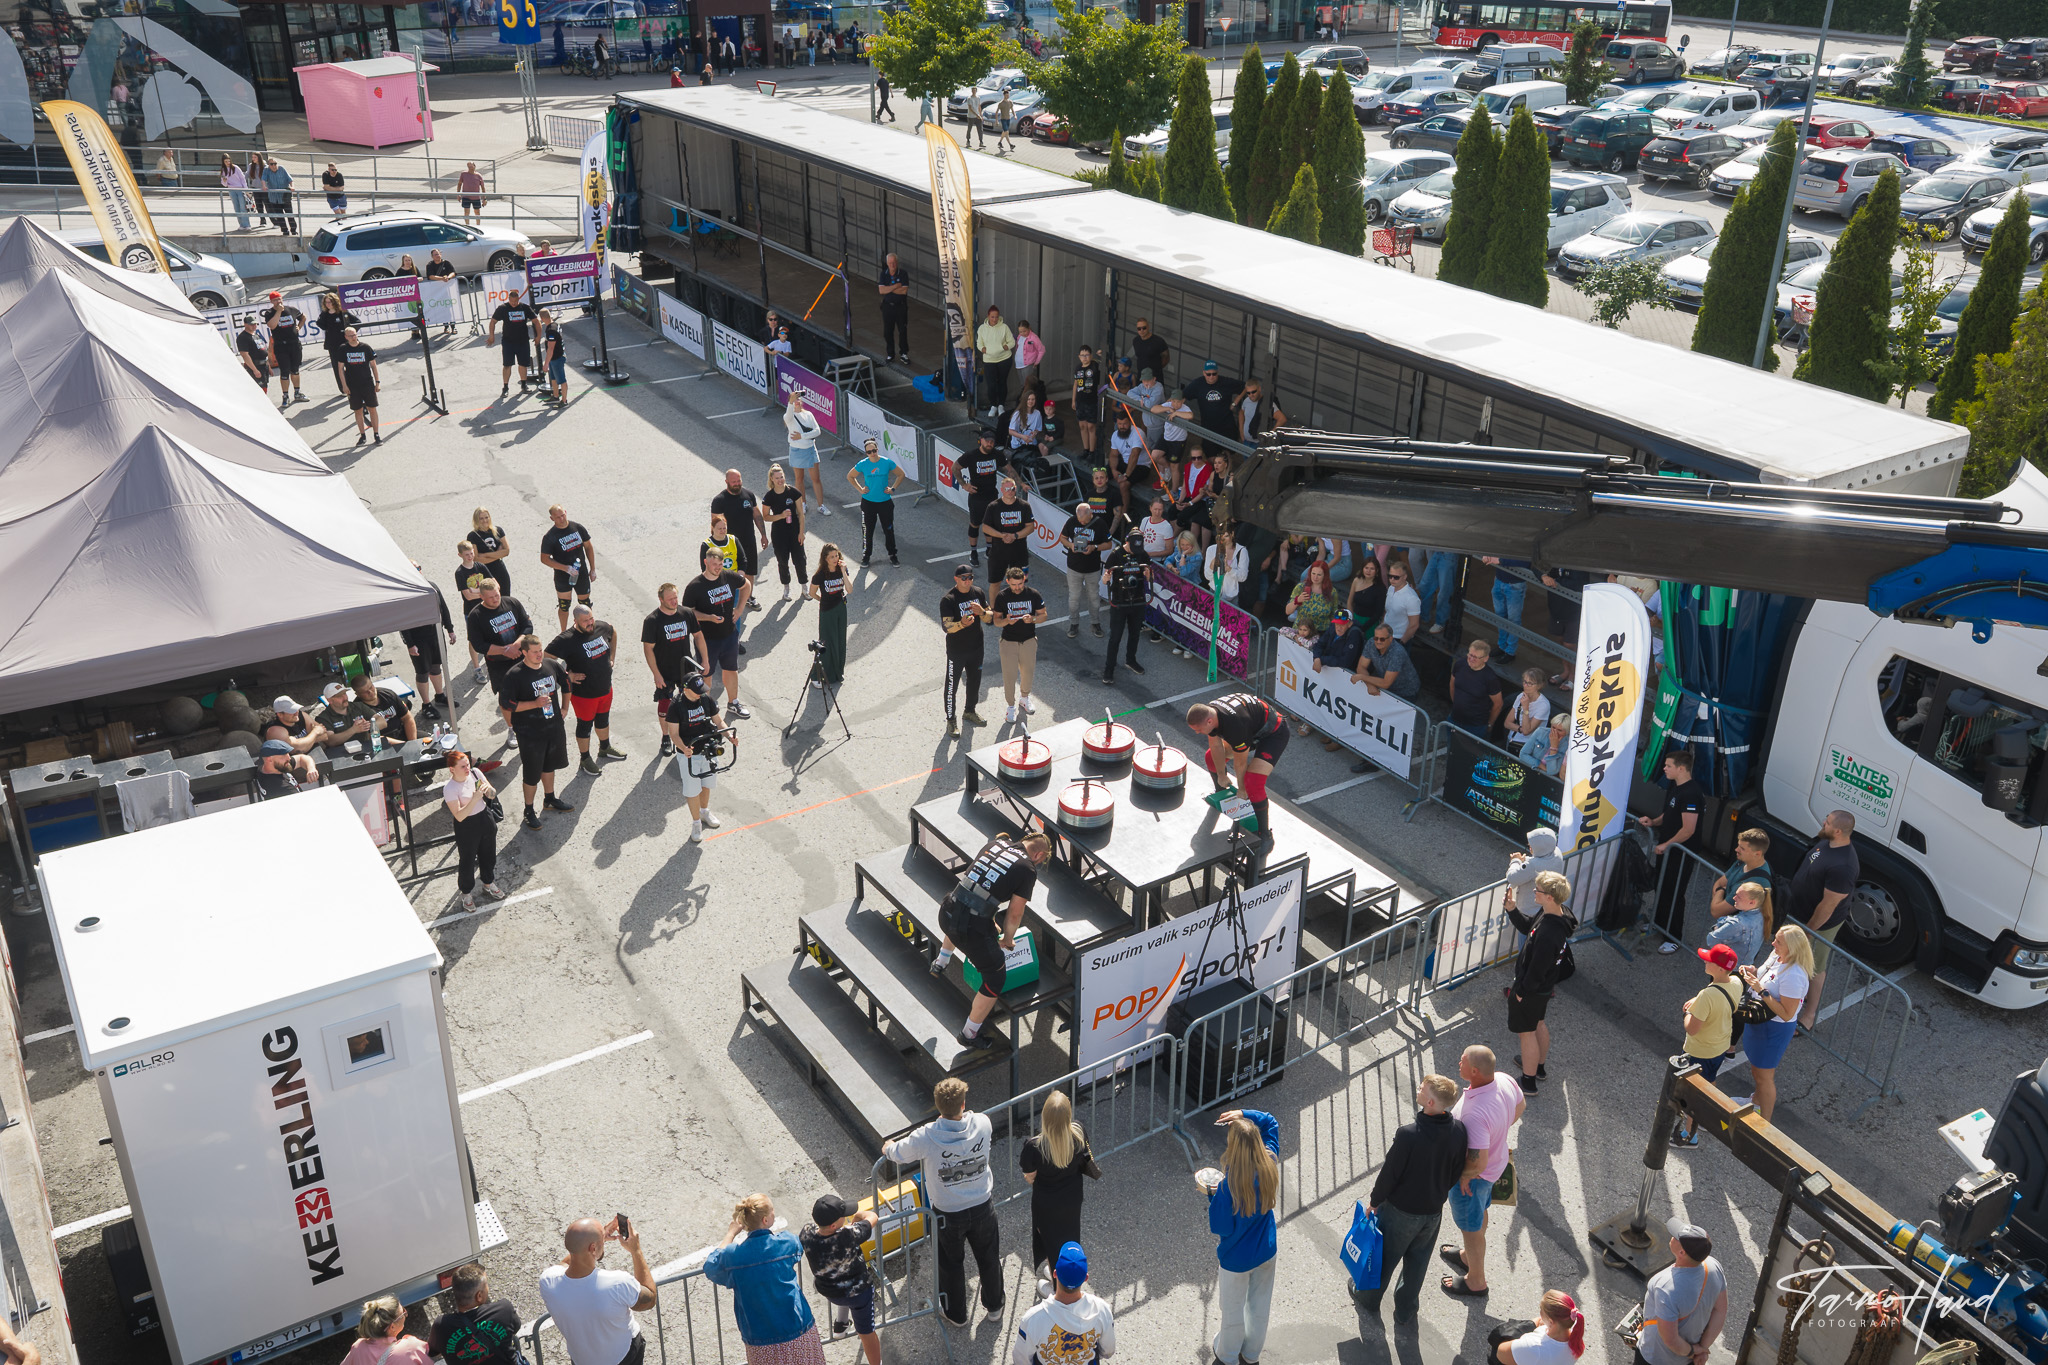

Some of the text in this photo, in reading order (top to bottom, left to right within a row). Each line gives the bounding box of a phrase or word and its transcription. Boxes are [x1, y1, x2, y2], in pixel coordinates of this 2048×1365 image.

[547, 260, 595, 274] KLEEBIKUM
[364, 284, 416, 298] KLEEBIKUM
[428, 297, 457, 309] Grupp
[351, 303, 403, 317] Woodwell
[668, 314, 703, 347] KASTELLI
[725, 333, 753, 363] EESTI
[727, 352, 766, 388] HALDUS
[939, 462, 951, 480] 24
[1169, 598, 1240, 649] KLEEBIKM.EE
[1302, 677, 1408, 756] KASTELLI
[1834, 780, 1853, 792] +372
[1859, 791, 1874, 802] 409
[1874, 798, 1889, 809] 090
[1837, 771, 1884, 795] TRANSPORT
[1467, 788, 1518, 823] ATHLETE
[1476, 801, 1506, 821] BYTES
[1832, 789, 1886, 818] +372 51 22 459
[1091, 944, 1143, 971] Suurim
[1147, 927, 1178, 952] valik
[1092, 925, 1287, 1031] POP SPORT!
[129, 1050, 175, 1071] ALRO
[132, 1319, 161, 1336] ALRO
[247, 1322, 312, 1356] 356 YPY
[446, 1320, 508, 1354] THREE SICE LIFE
